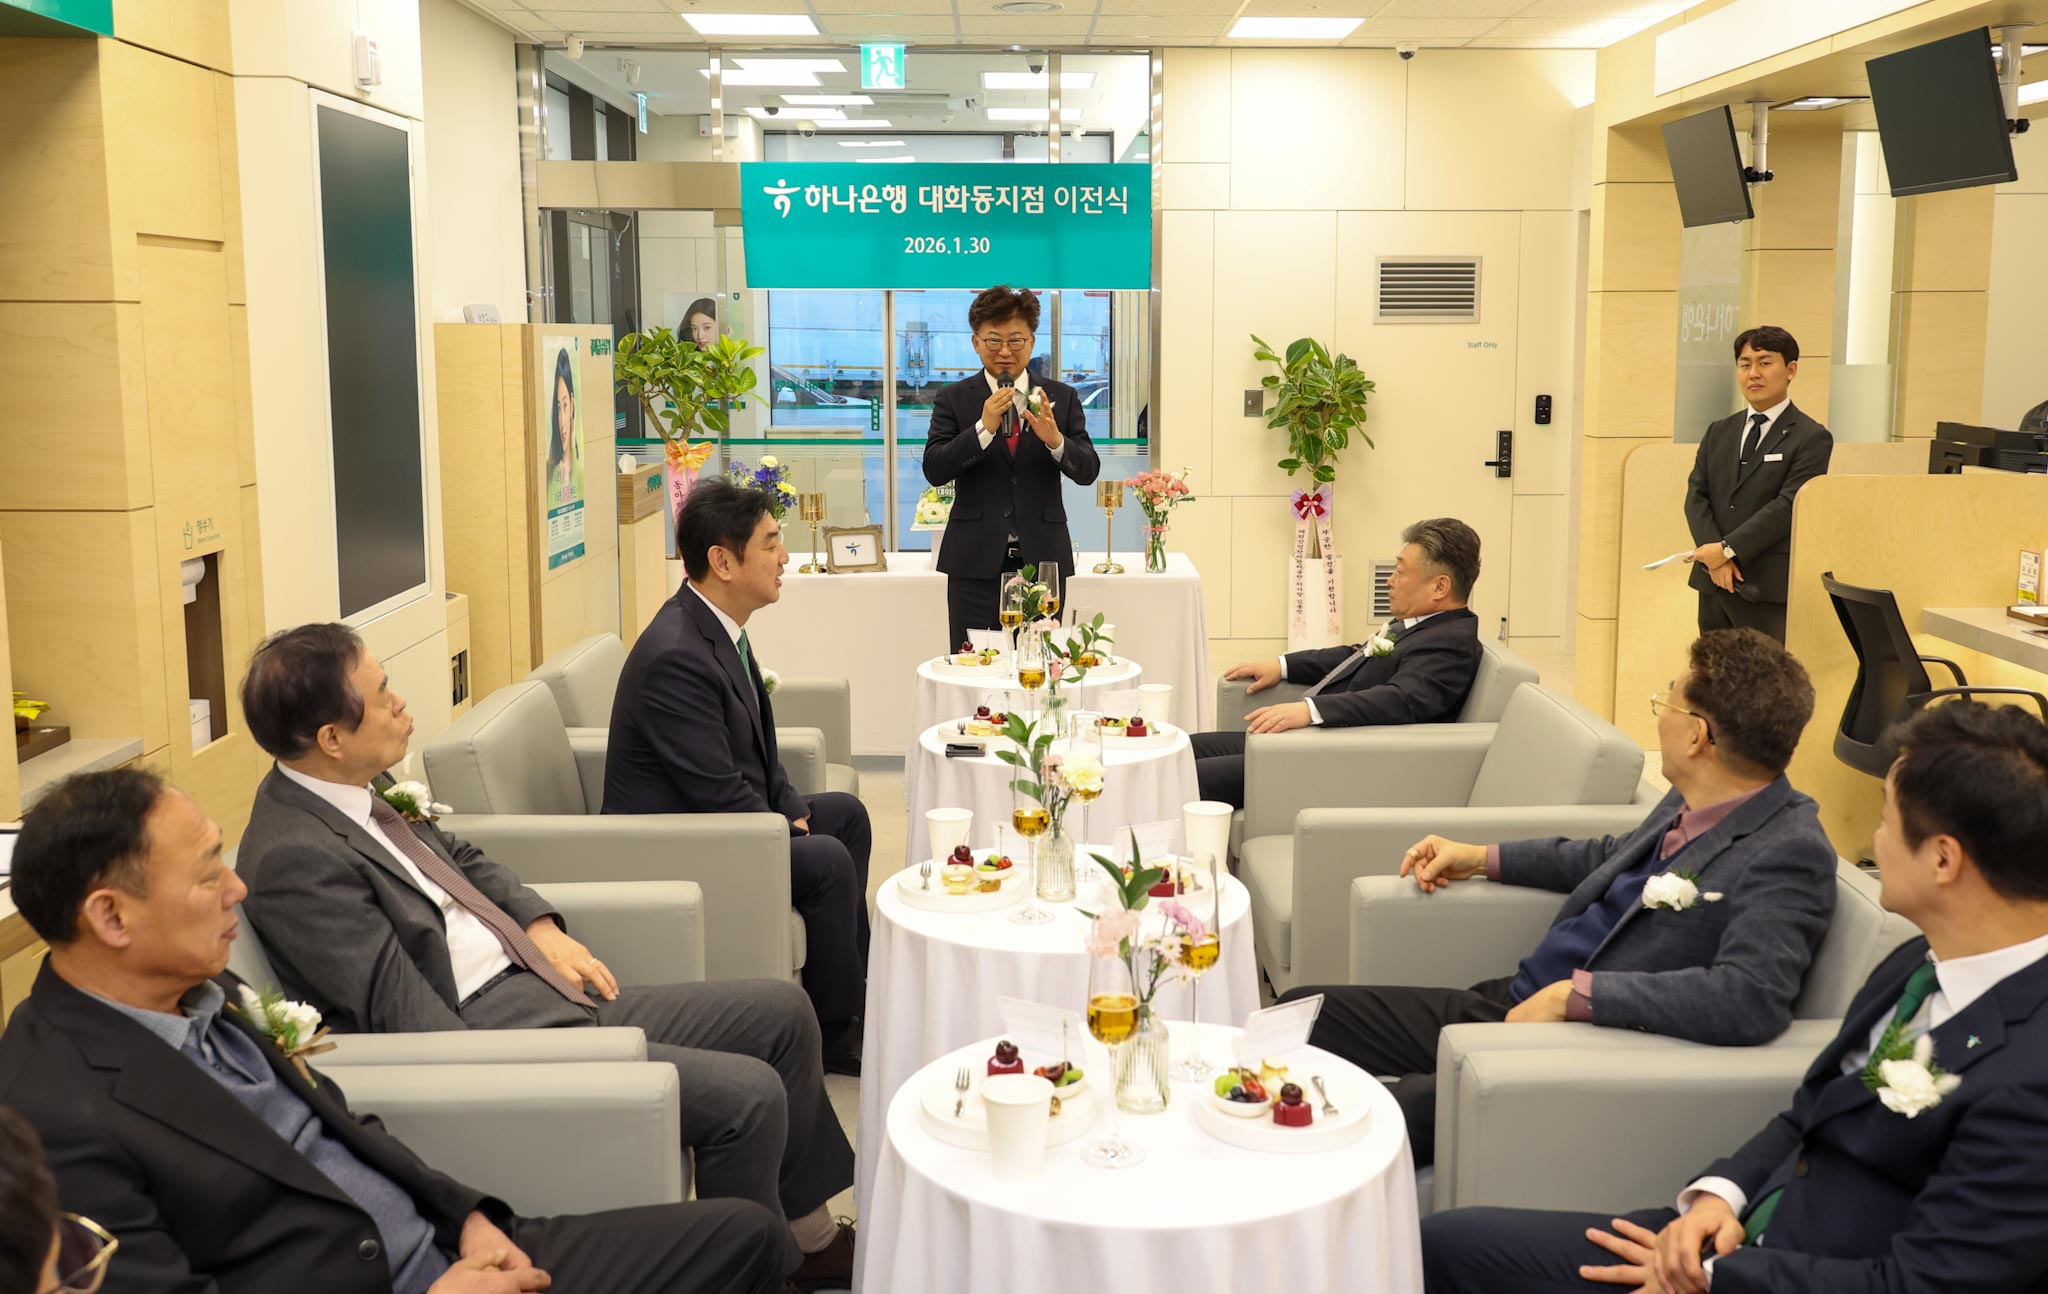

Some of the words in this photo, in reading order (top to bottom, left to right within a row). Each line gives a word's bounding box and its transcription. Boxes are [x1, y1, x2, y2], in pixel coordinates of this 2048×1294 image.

[804, 184, 907, 214] 하나은행
[918, 184, 1044, 214] 대화동지점
[1053, 185, 1128, 215] 이전식
[904, 236, 991, 255] 2026.1.30
[1467, 341, 1482, 349] Staff
[1483, 341, 1498, 350] Only
[196, 518, 213, 534] 정수기
